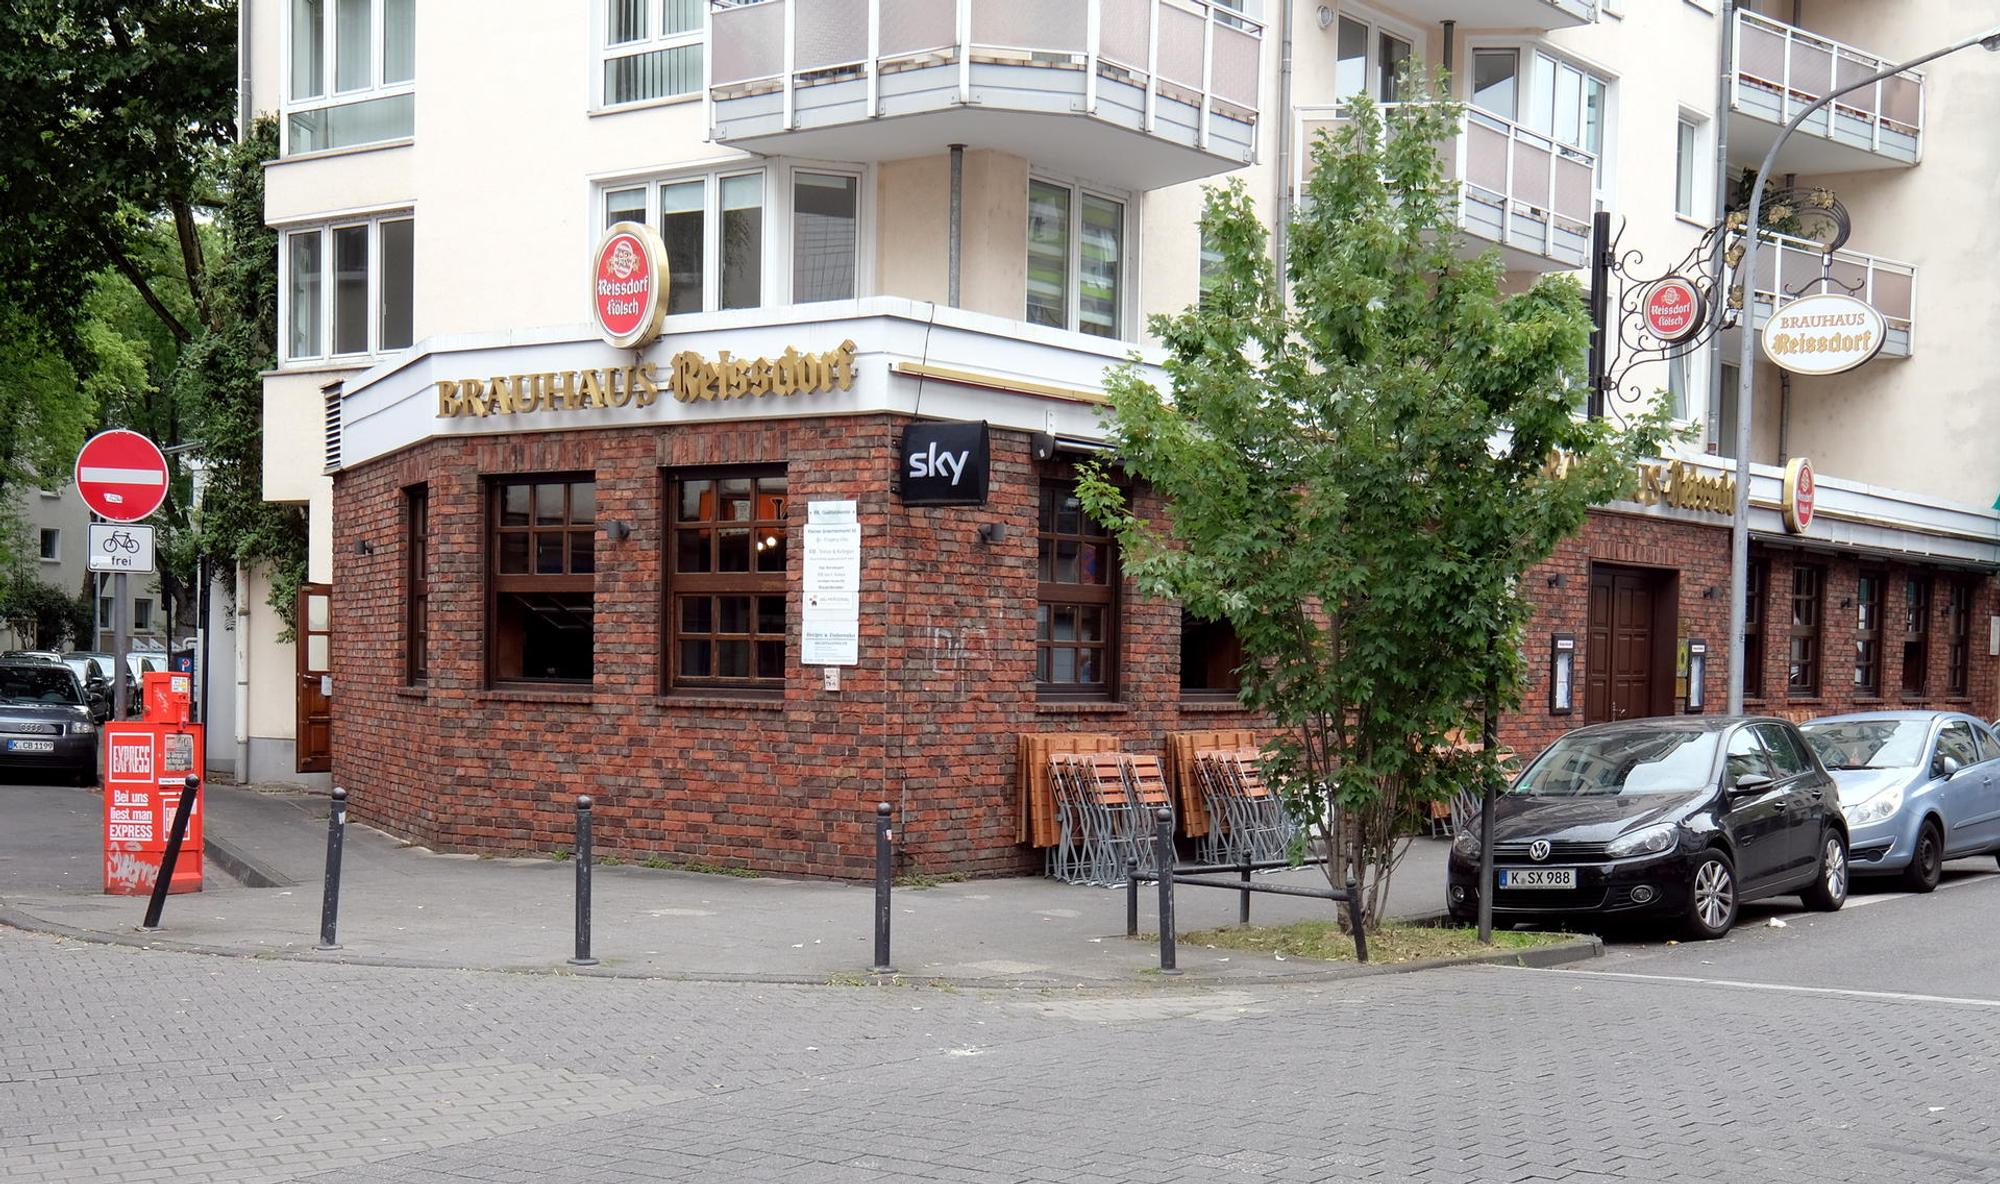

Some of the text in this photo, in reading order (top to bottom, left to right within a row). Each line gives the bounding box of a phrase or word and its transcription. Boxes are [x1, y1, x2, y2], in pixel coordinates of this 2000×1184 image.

[598, 276, 648, 296] Reissdorf
[607, 298, 639, 316] Kölsch
[1651, 302, 1691, 315] Reissdorf
[1780, 313, 1865, 329] BRAUHAUS
[1772, 330, 1872, 355] Reissdorf
[435, 338, 858, 418] BRAUHAUS Reissdorf
[909, 441, 969, 486] sky
[112, 555, 132, 566] frei
[113, 745, 150, 773] EXPRESS
[114, 790, 149, 803] Bei uns
[110, 806, 130, 820] liest
[132, 810, 152, 820] man
[109, 824, 153, 838] EXPRESS
[1511, 871, 1570, 885] K SX 988
